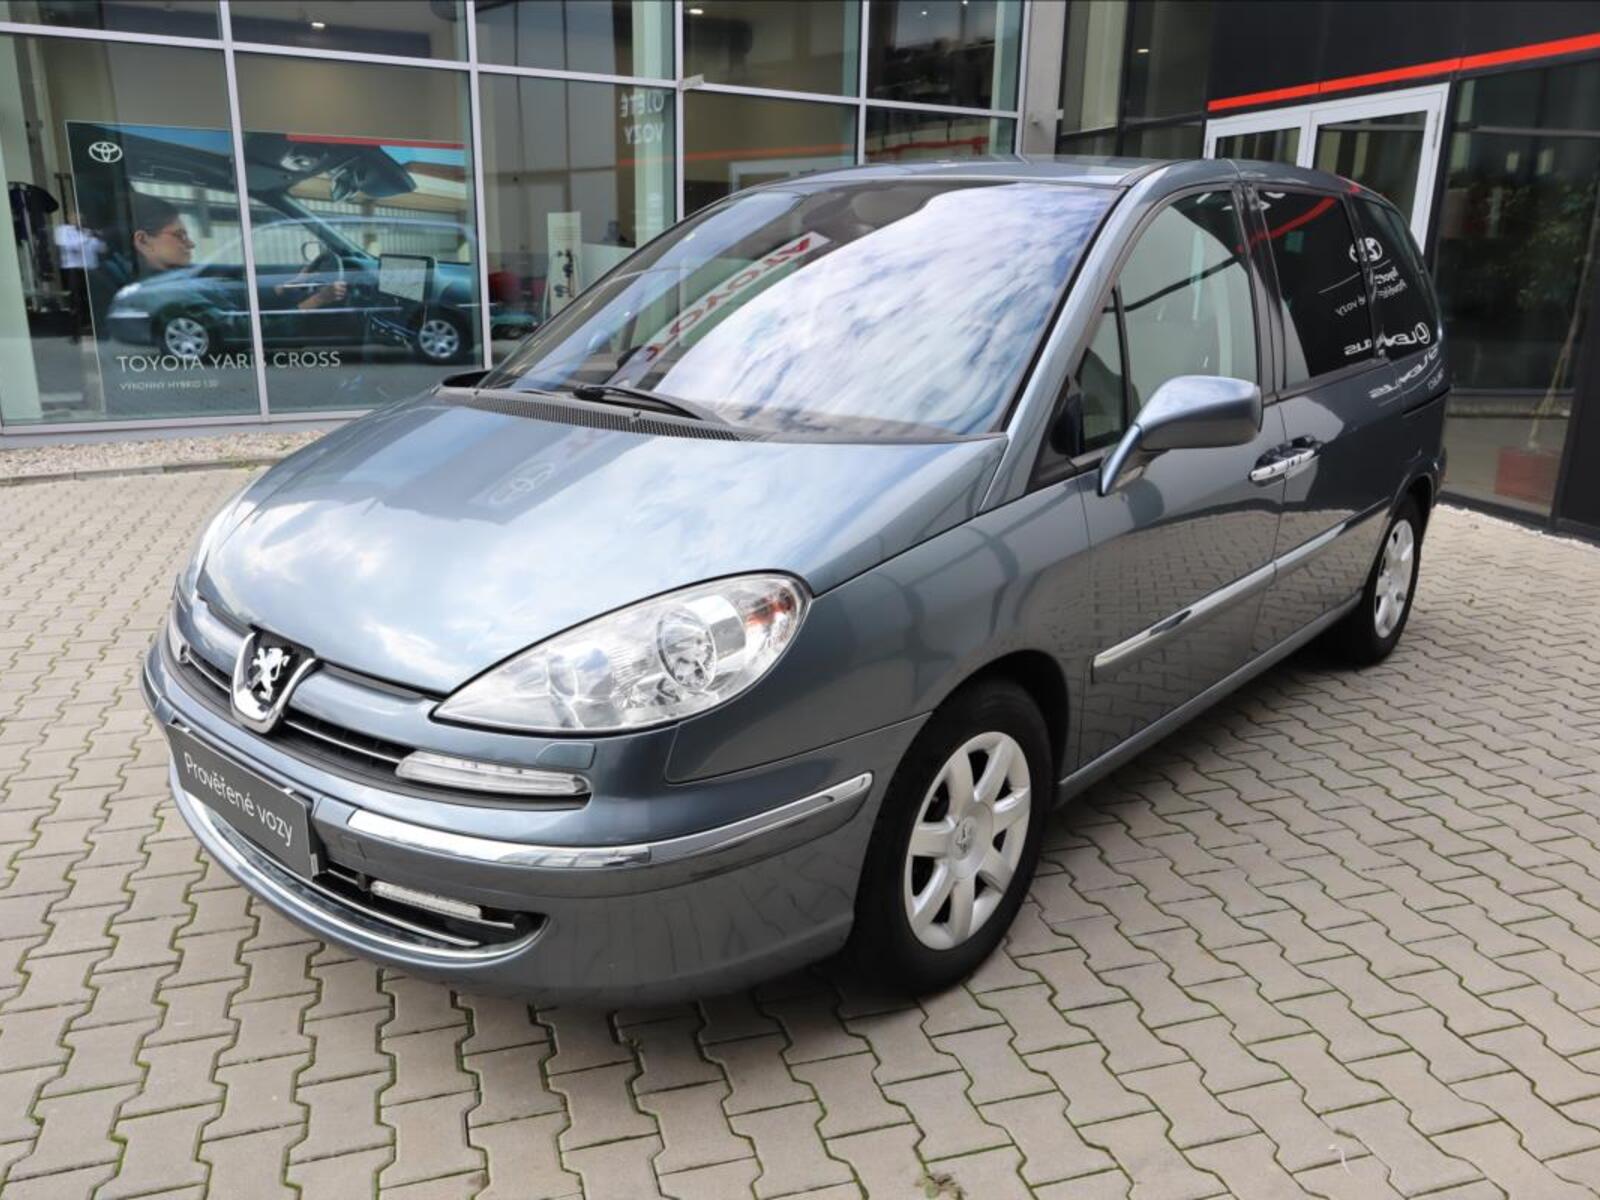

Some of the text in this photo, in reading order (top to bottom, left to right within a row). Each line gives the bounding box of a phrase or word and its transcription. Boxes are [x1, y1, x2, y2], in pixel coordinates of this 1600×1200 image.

[116, 351, 341, 373] TOYOTA YARI CROSS
[183, 751, 293, 847] Prověřené vozy
